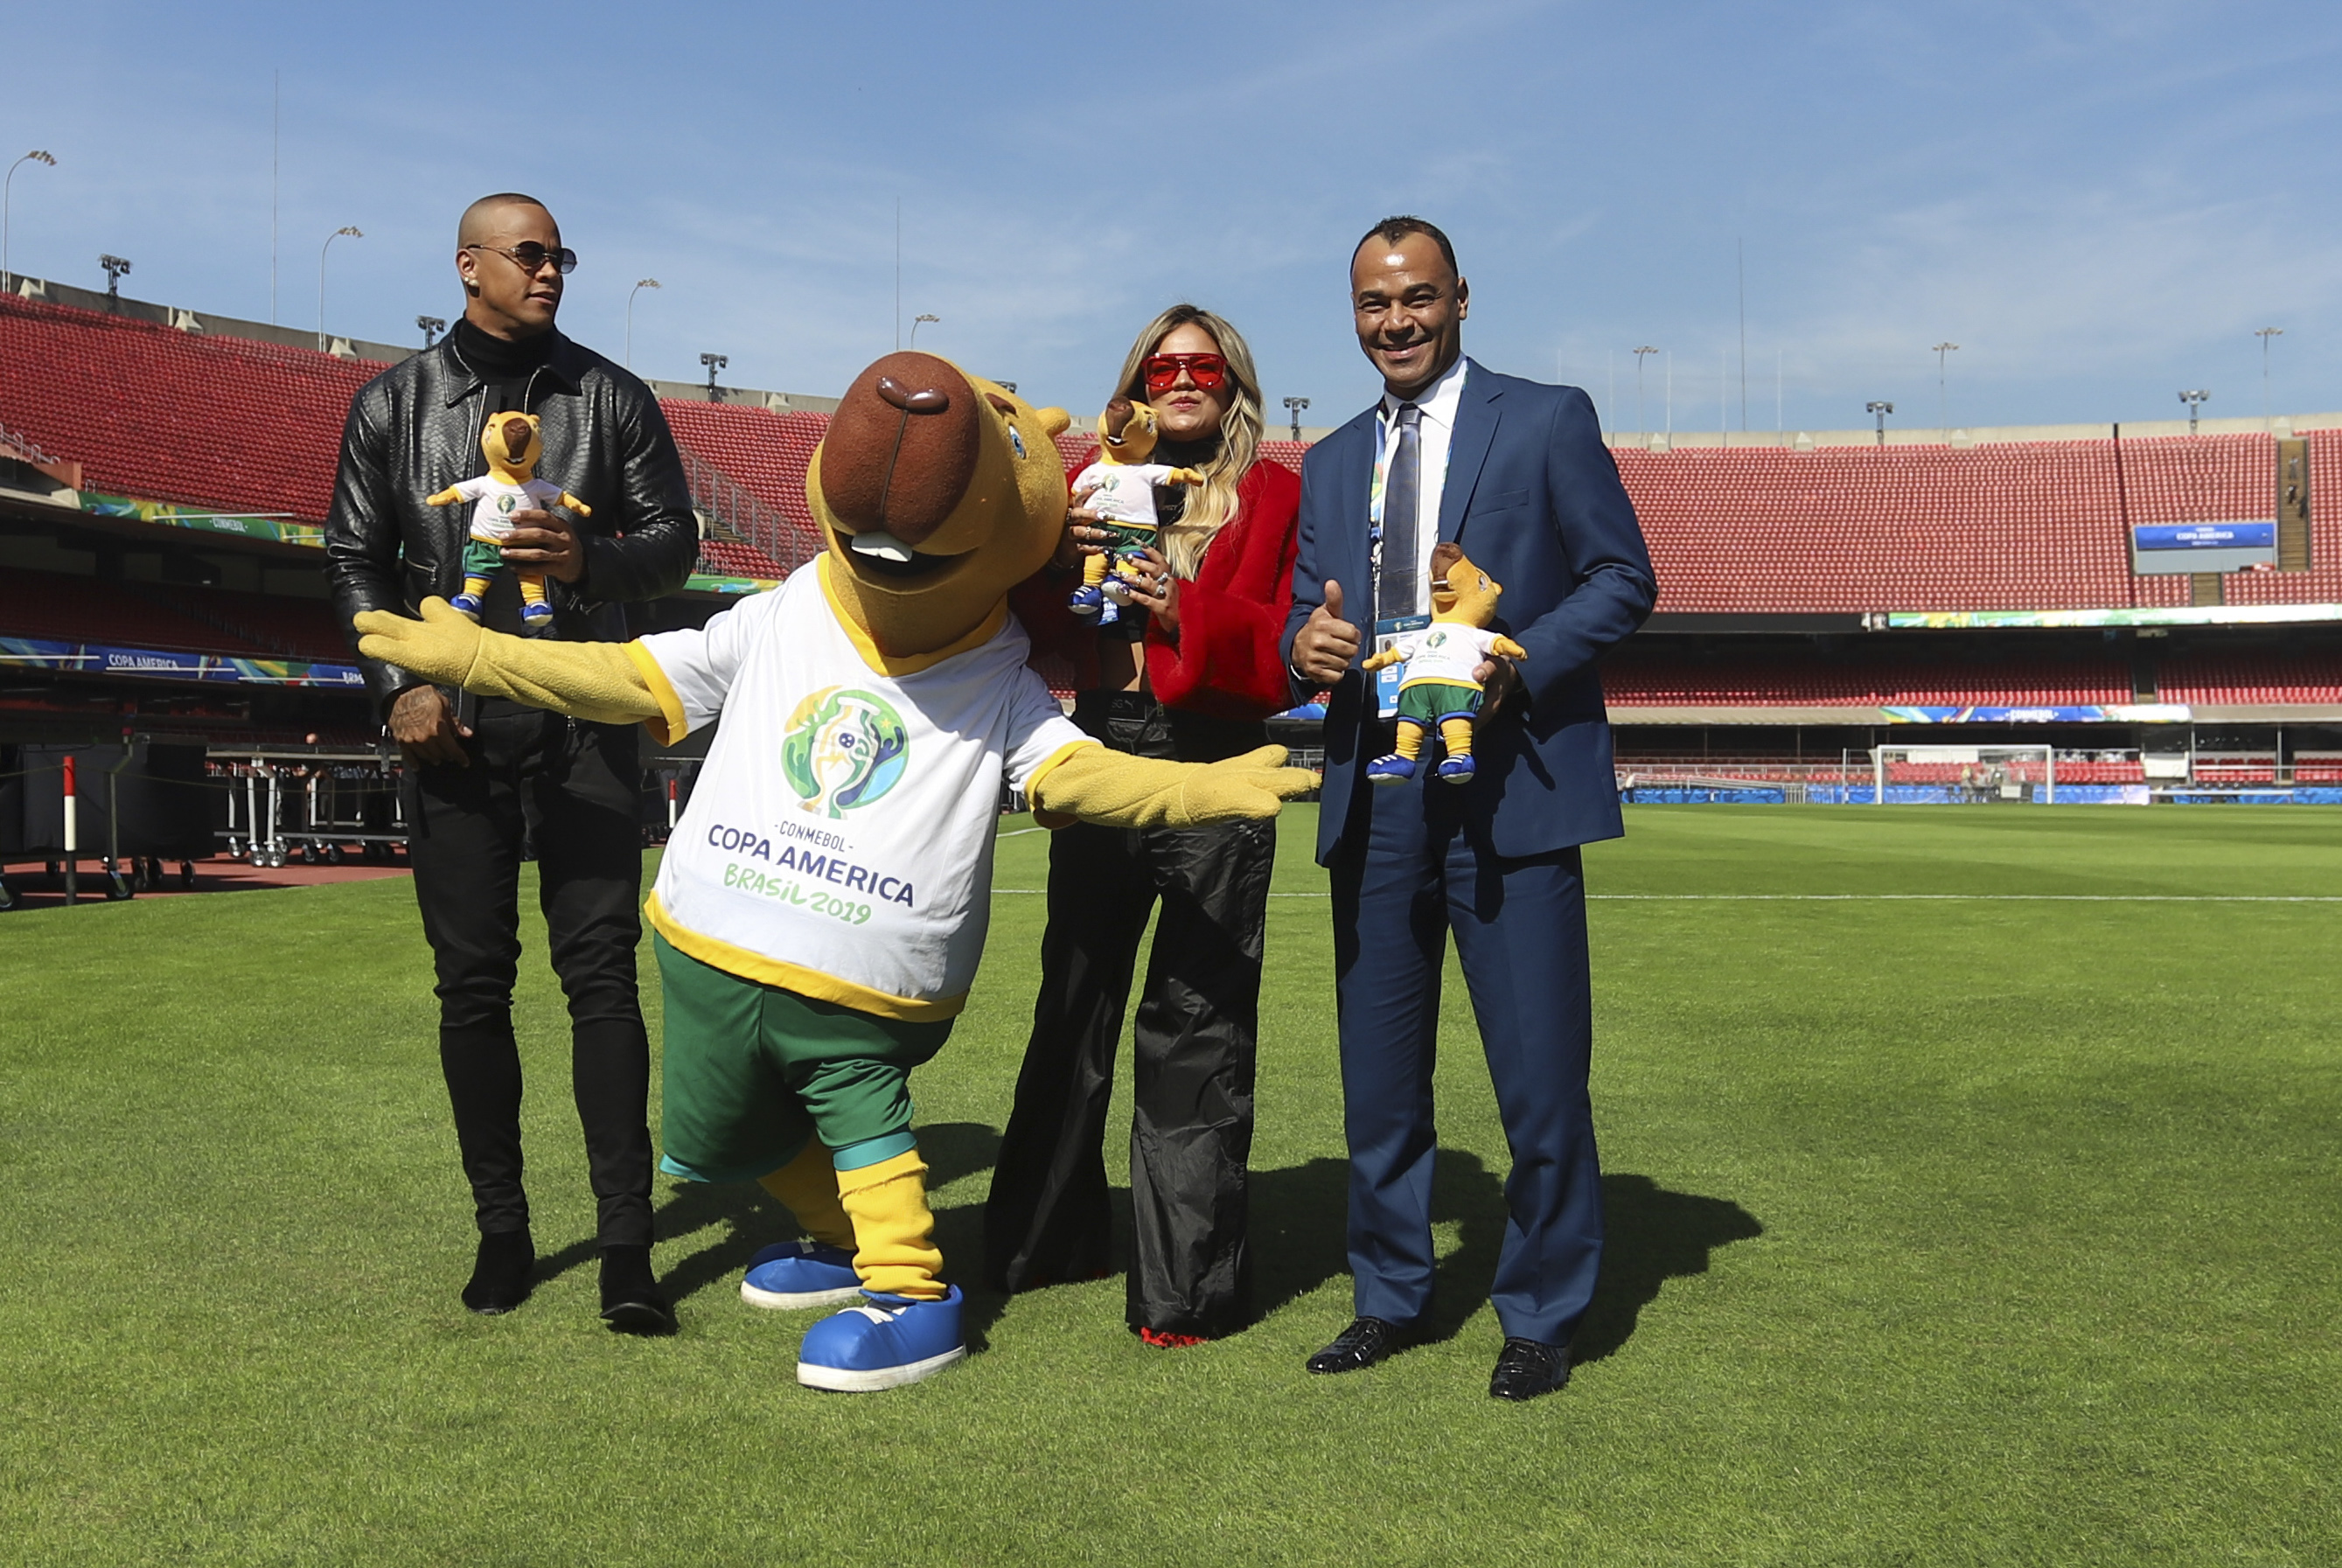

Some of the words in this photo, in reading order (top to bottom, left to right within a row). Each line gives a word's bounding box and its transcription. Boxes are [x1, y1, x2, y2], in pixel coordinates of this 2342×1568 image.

[108, 653, 136, 668] COPA
[136, 656, 178, 670] AMERICA
[707, 824, 770, 861] COPA
[776, 846, 914, 908] AMERICA
[809, 891, 872, 926] 2019
